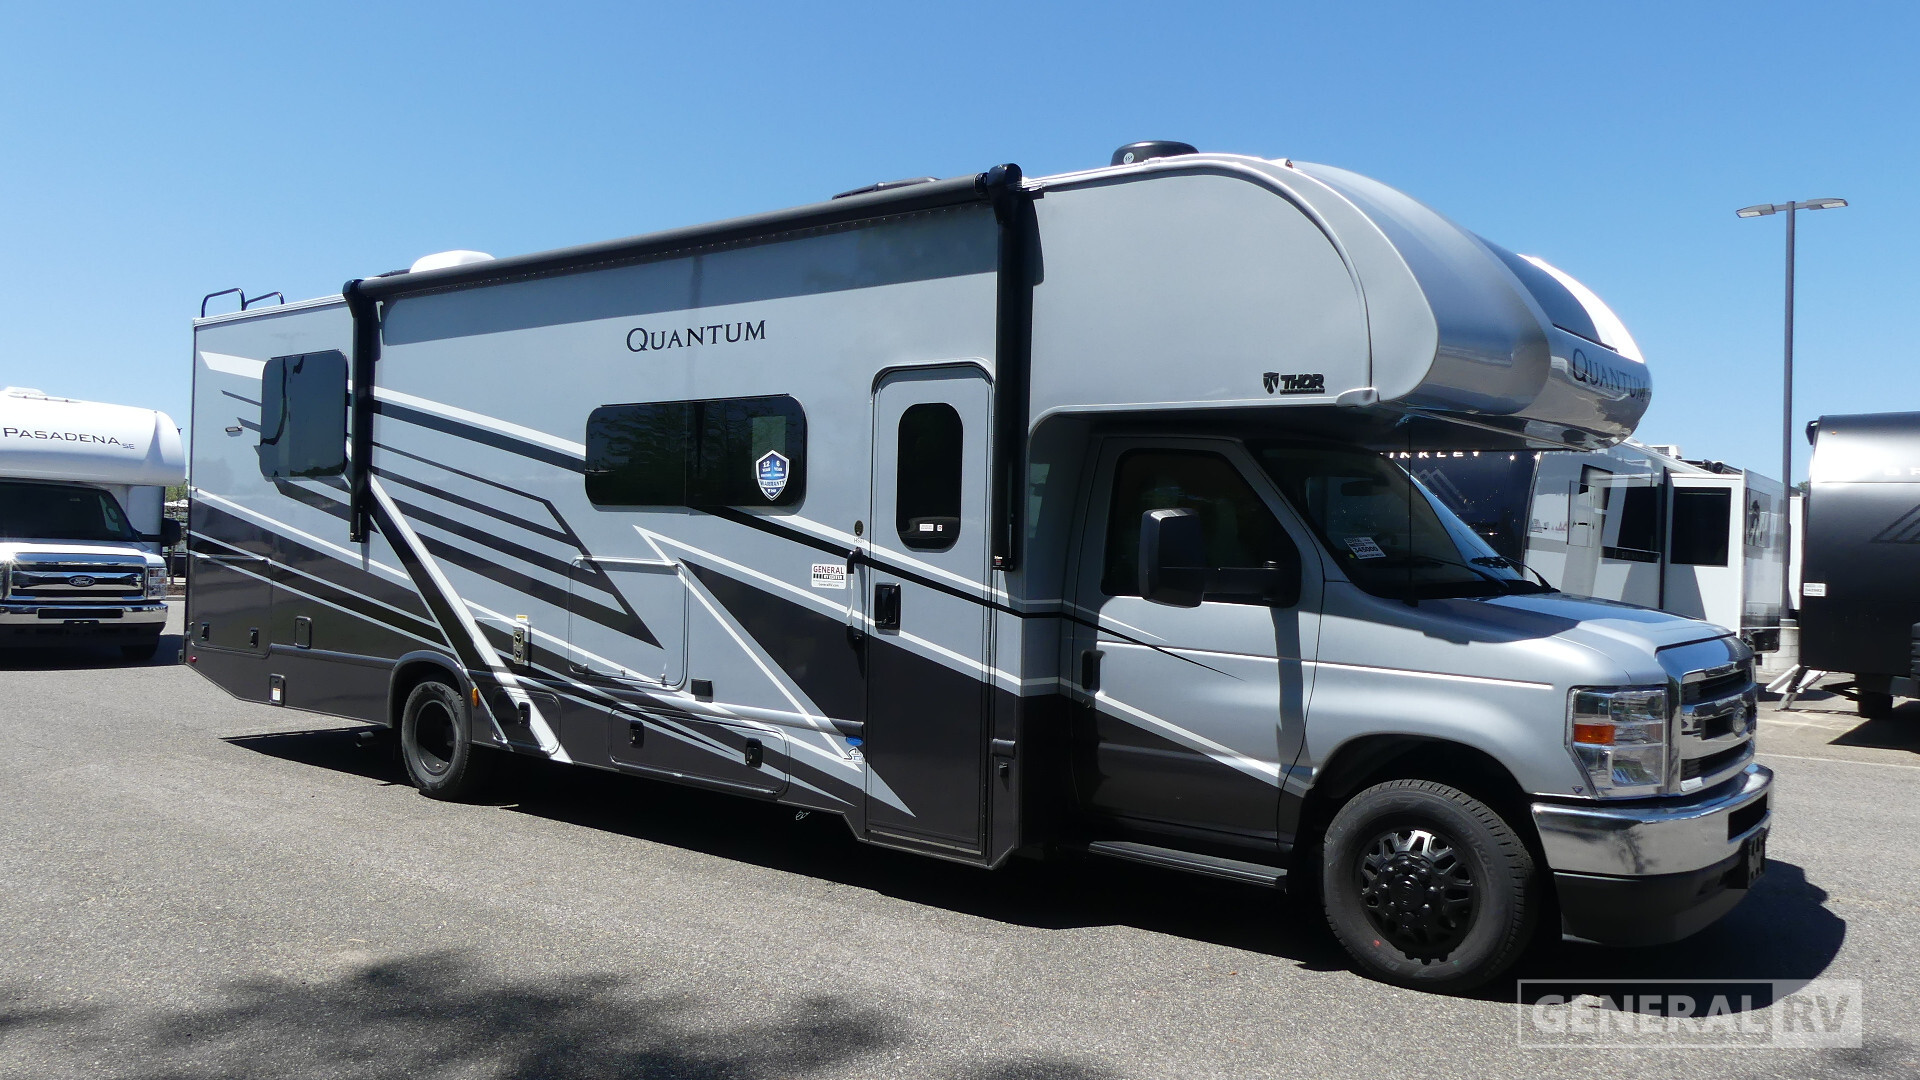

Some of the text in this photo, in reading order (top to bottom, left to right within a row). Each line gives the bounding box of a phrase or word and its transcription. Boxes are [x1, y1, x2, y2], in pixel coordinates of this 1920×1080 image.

[1280, 373, 1325, 390] THOR
[759, 479, 786, 487] WARRANTY
[813, 565, 845, 575] GENERAL
